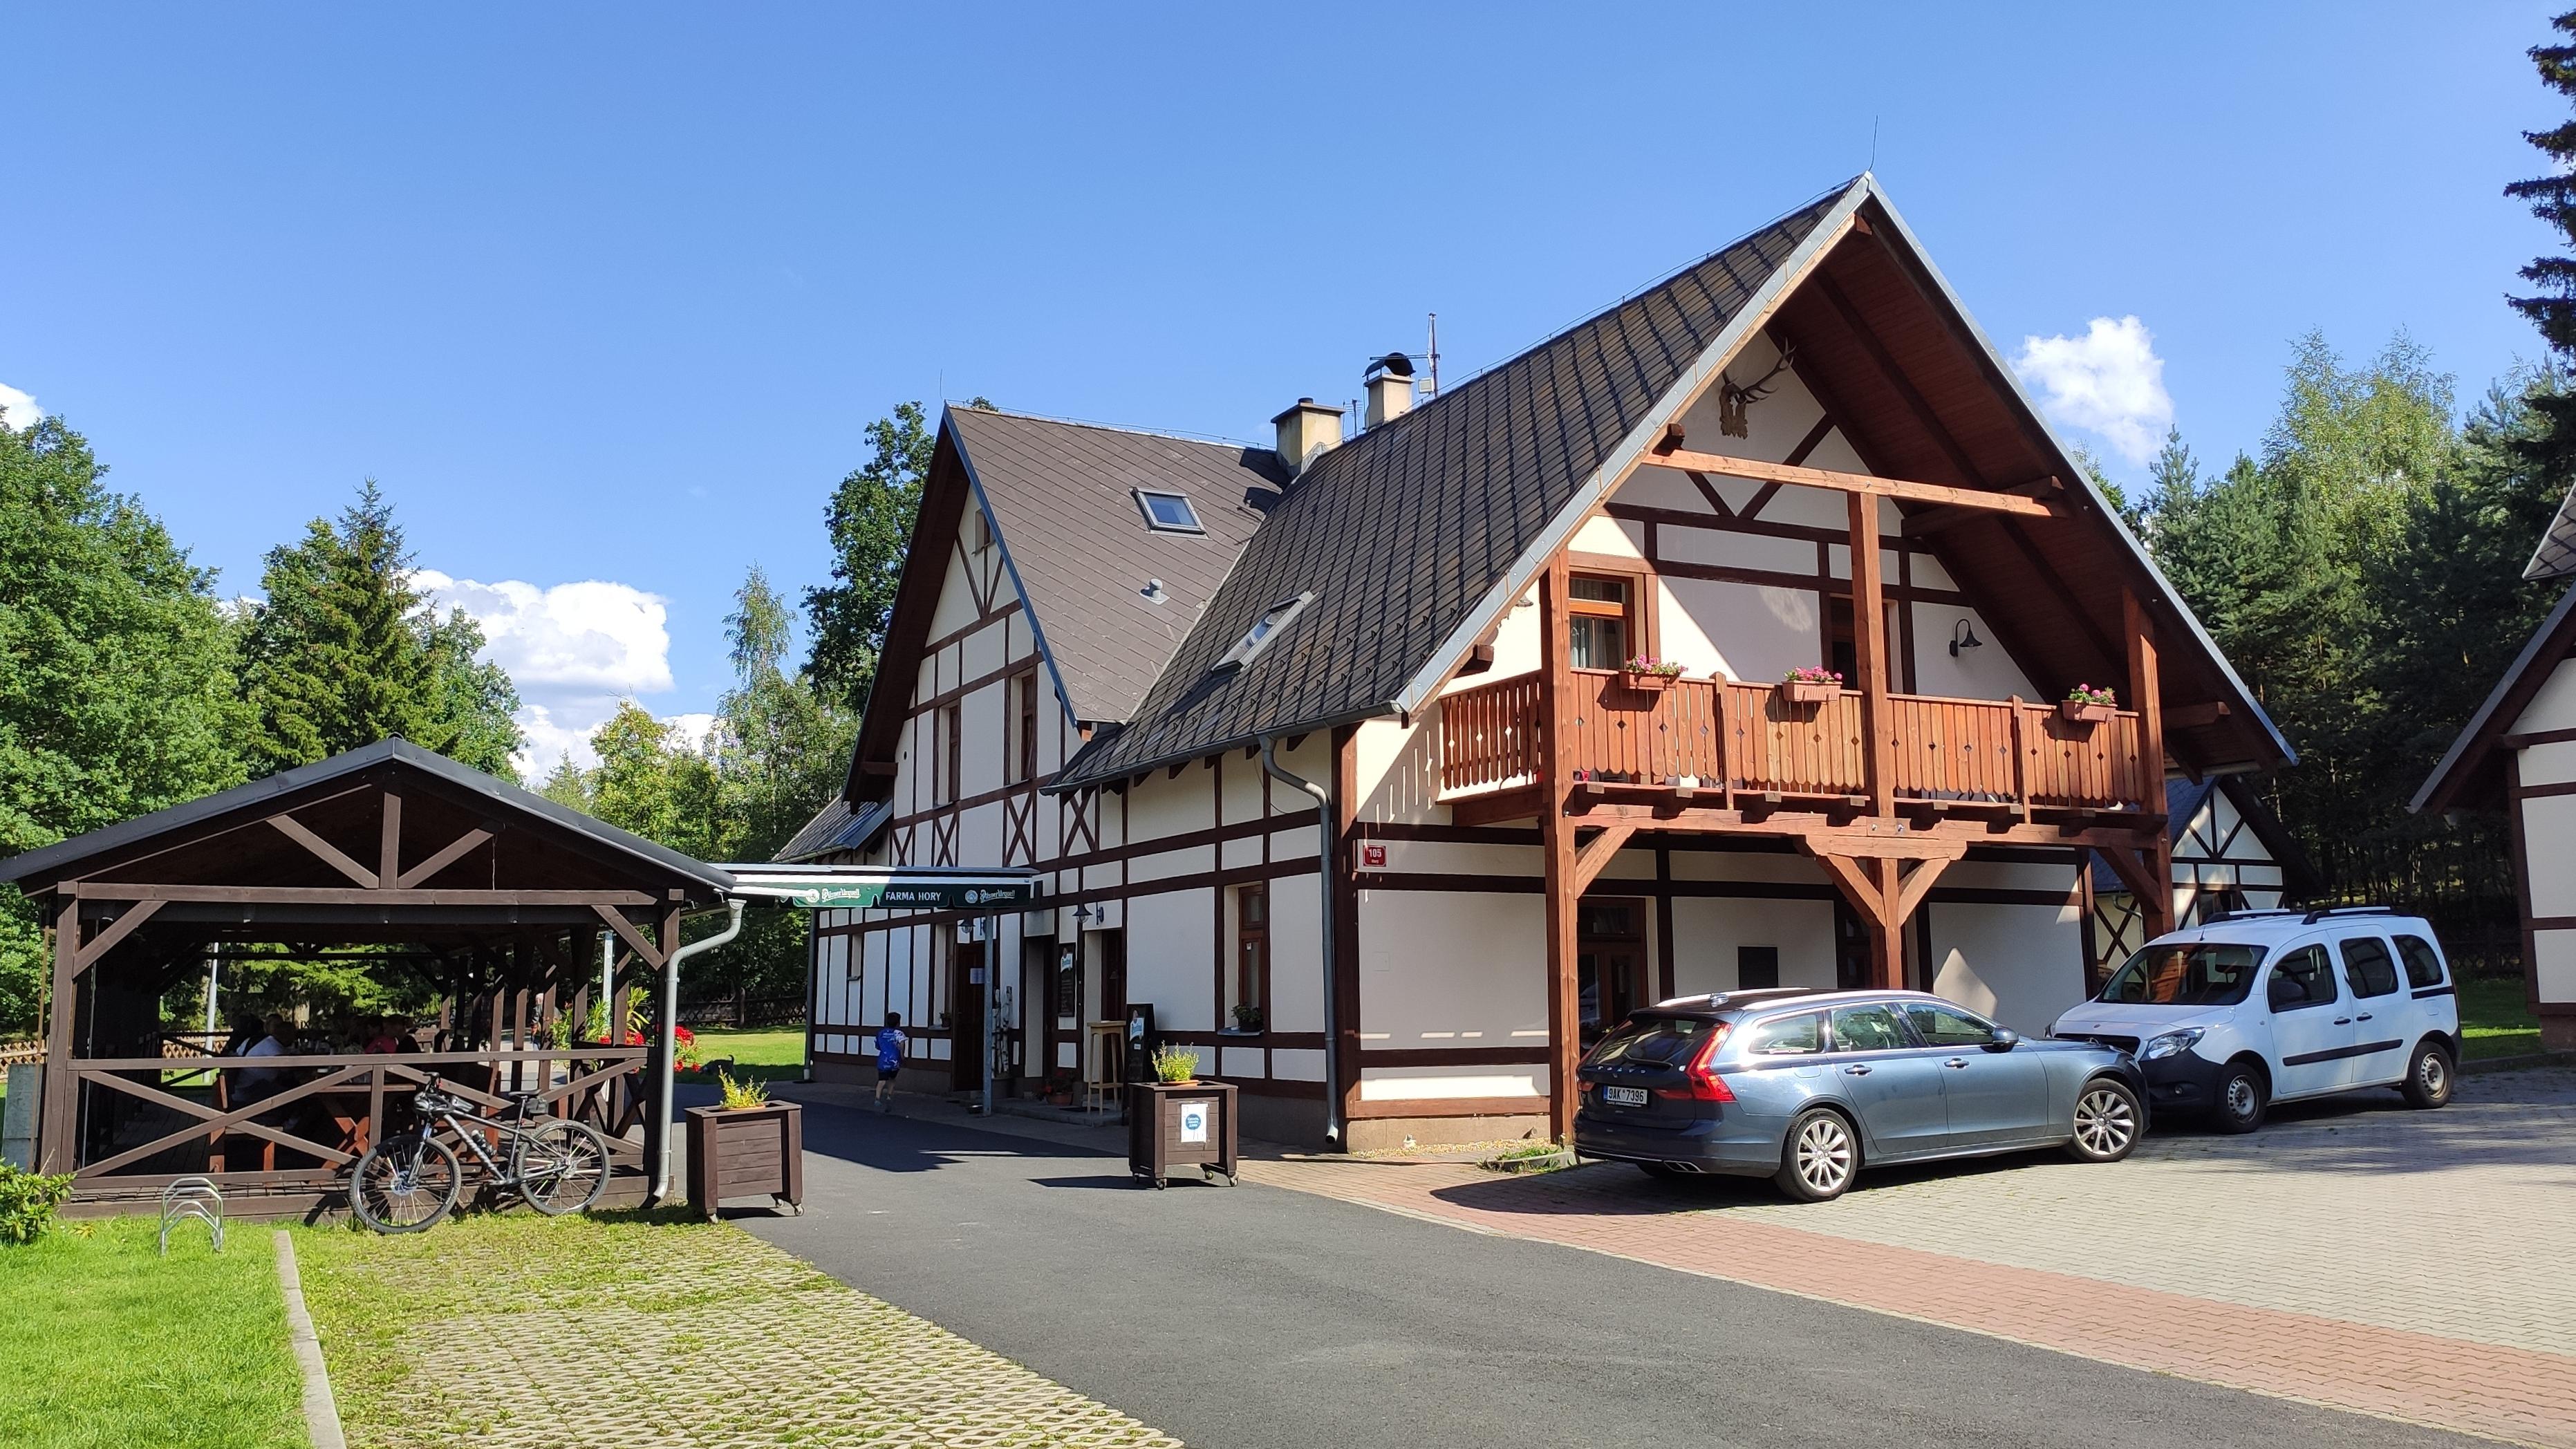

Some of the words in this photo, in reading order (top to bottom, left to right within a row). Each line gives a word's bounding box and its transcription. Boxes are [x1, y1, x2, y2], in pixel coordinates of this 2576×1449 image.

[1368, 848, 1382, 857] 105
[886, 891, 915, 901] FARMA
[918, 891, 942, 901] HORY
[1609, 1088, 1621, 1100] 9AK
[1626, 1090, 1644, 1102] 7396
